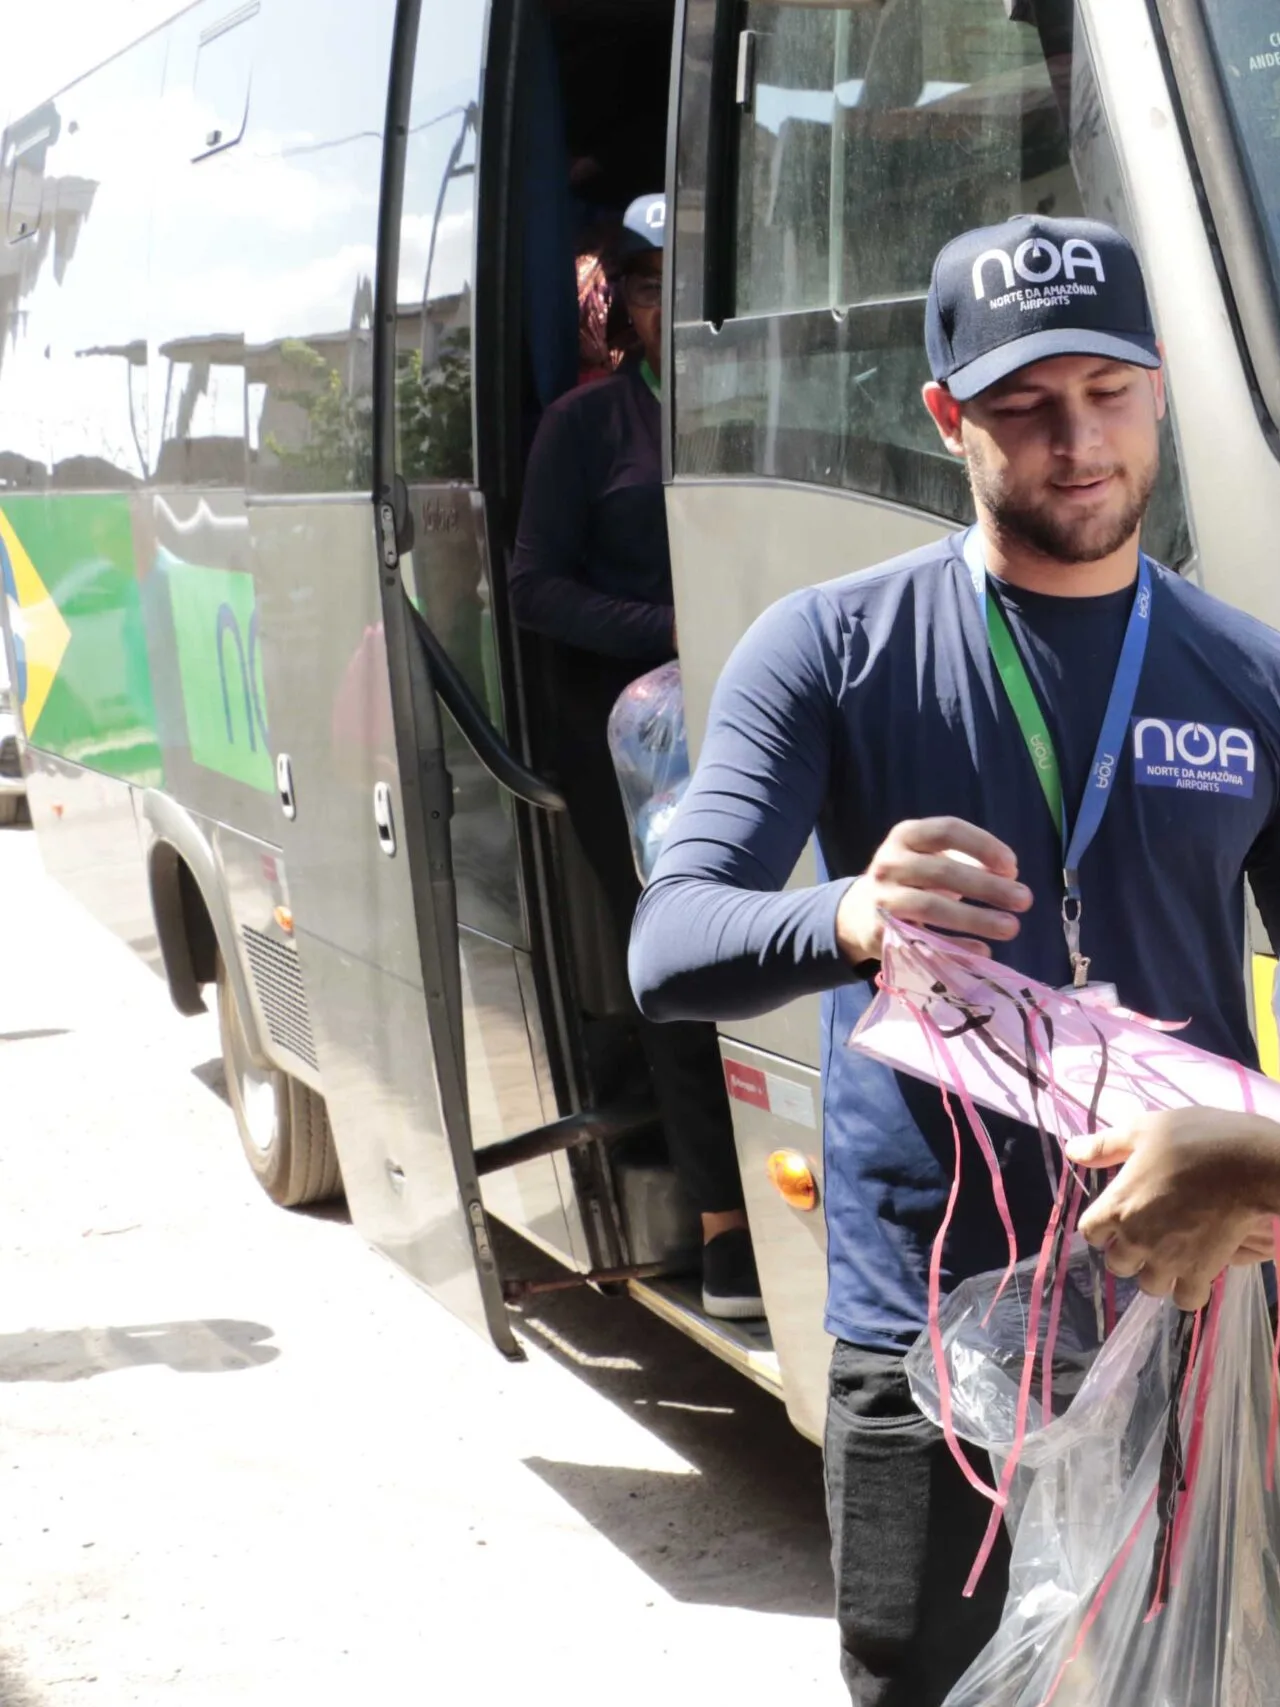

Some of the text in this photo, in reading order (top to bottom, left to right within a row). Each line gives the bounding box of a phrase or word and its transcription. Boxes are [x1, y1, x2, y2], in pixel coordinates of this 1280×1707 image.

[989, 282, 1098, 310] NORTE DA AMAZÔNIA
[1020, 295, 1070, 312] AIRPORTS
[1147, 765, 1243, 786] NORTE DA AMAZÔNIA
[1176, 778, 1220, 793] AIRPORTS
